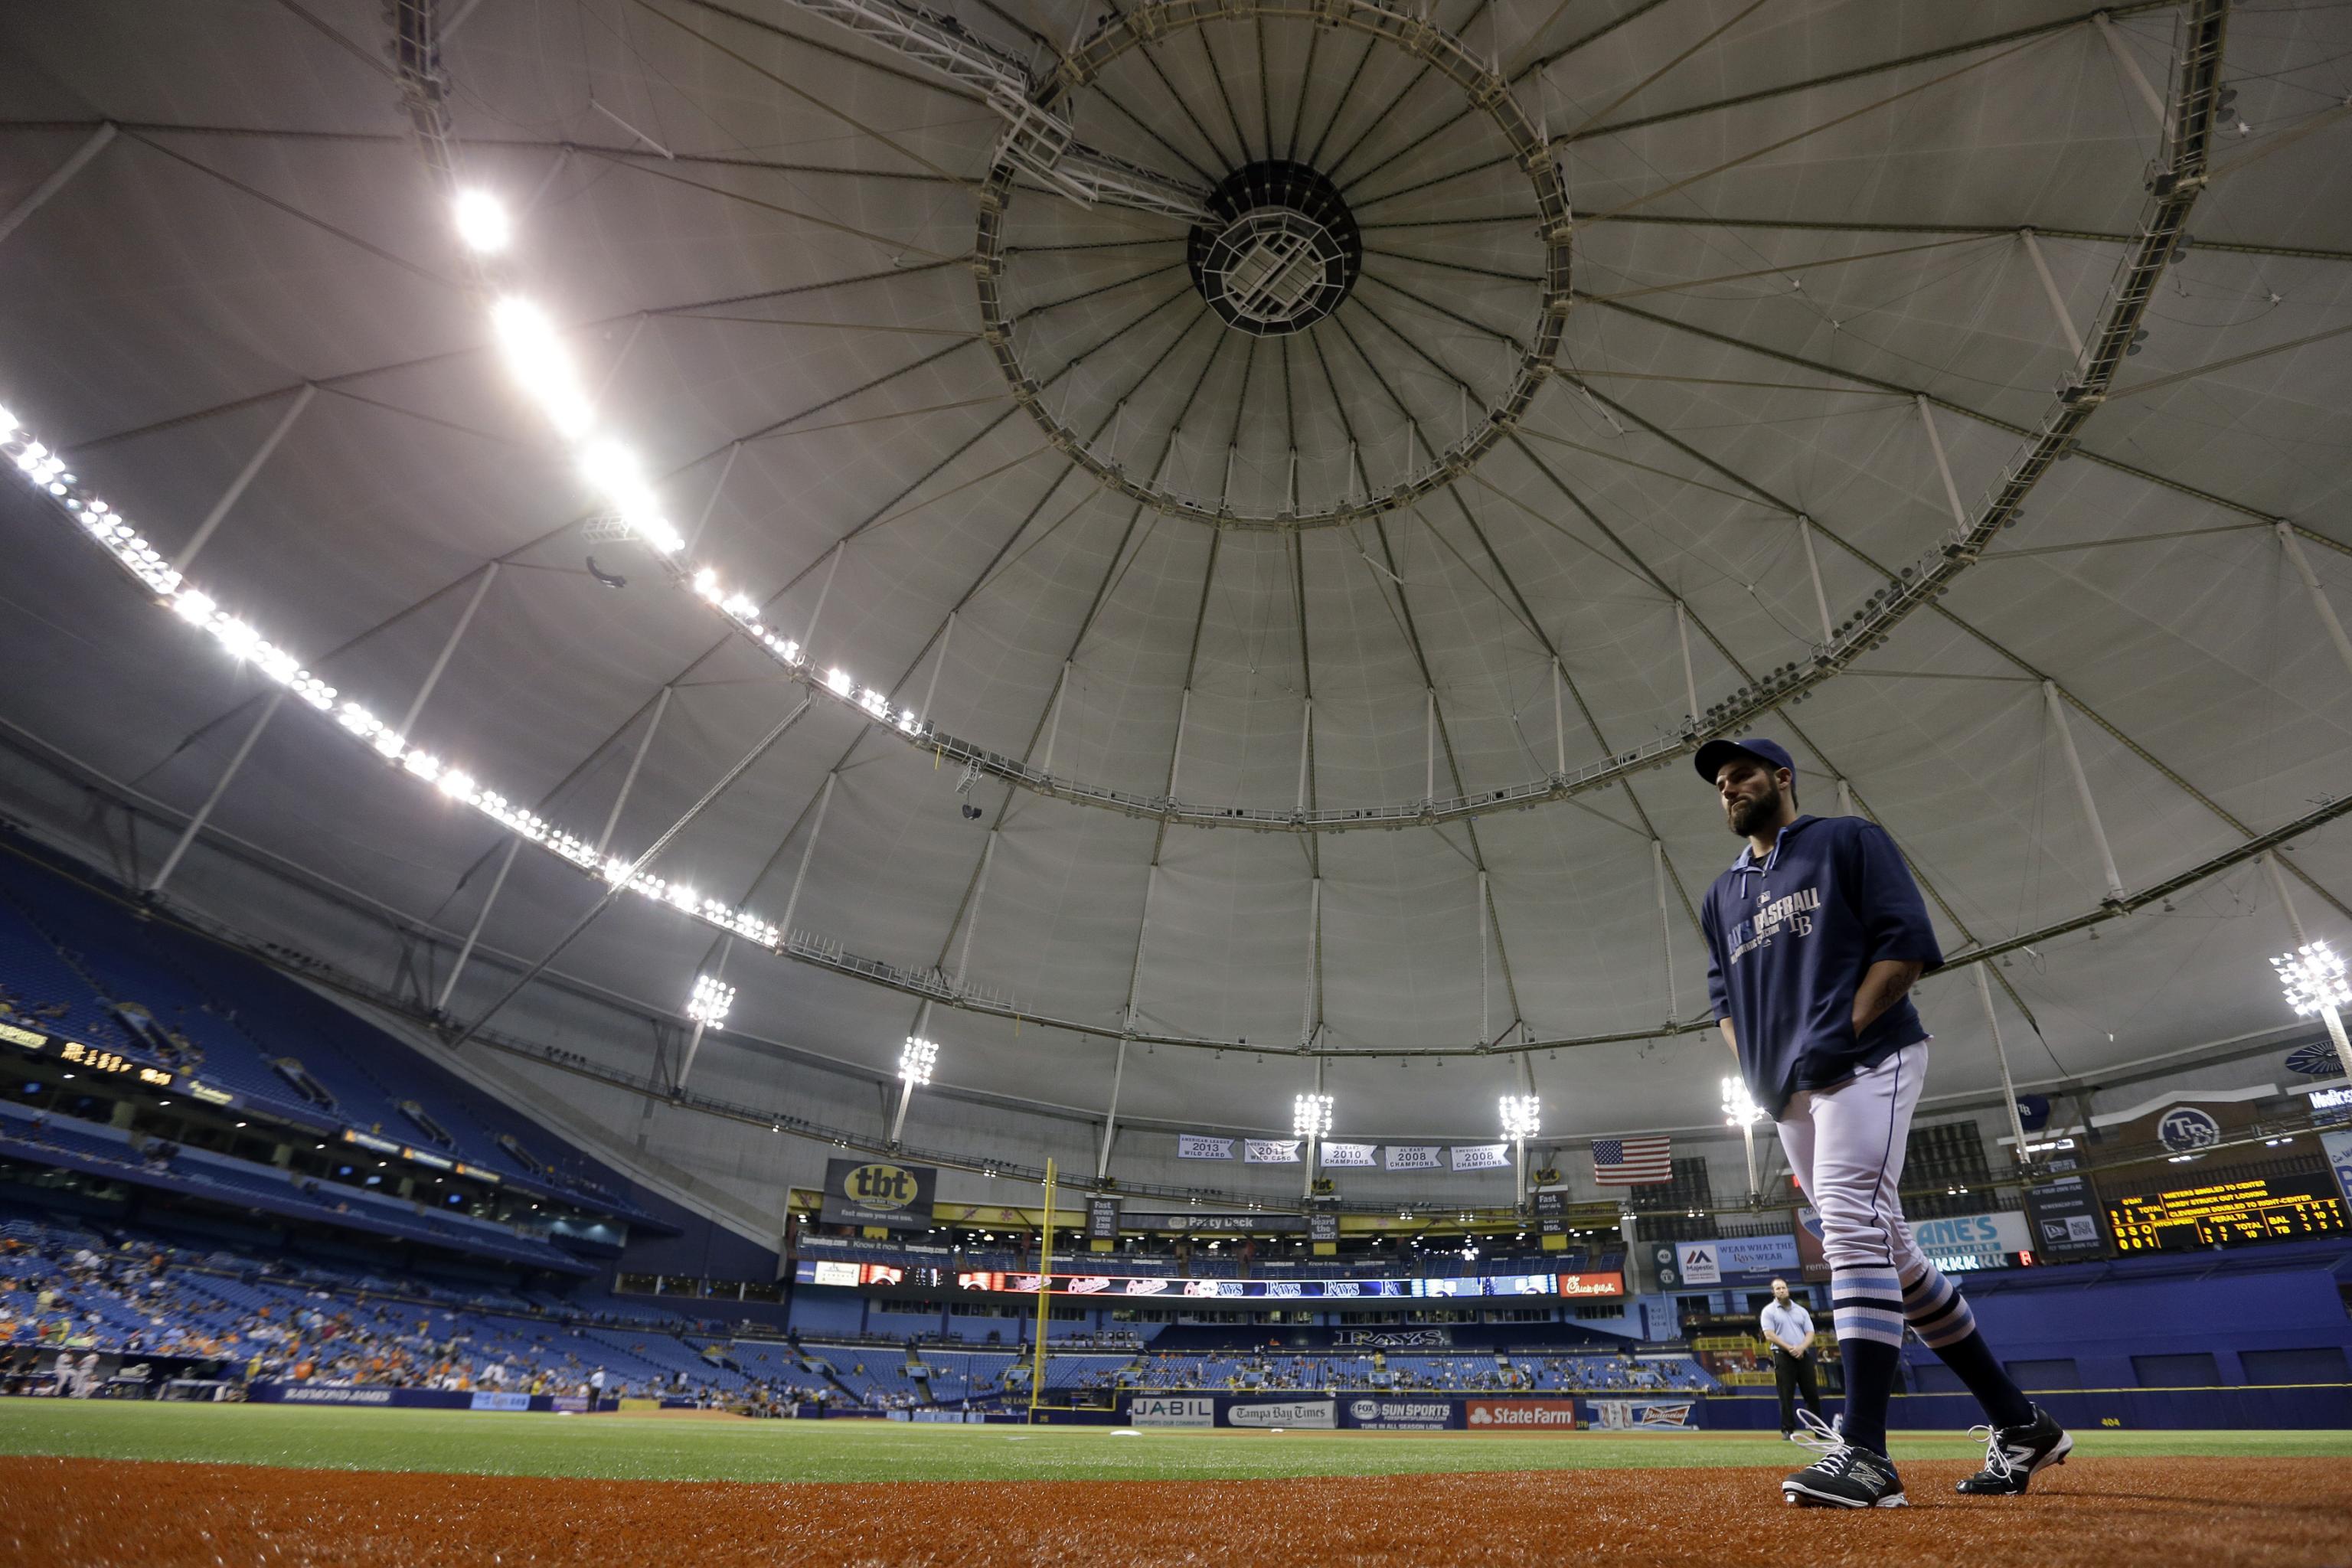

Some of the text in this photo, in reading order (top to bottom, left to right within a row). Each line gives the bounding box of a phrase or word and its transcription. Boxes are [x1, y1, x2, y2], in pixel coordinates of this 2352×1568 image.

[1753, 887, 1821, 935] BASEBALL
[1783, 911, 1812, 937] TB
[1193, 1143, 1219, 1152] 2013
[1334, 1151, 1361, 1159] 2010
[1398, 1152, 1426, 1161] 2008
[1465, 1152, 1493, 1161] 2008
[1456, 1160, 1502, 1168] CHAMPIONS
[856, 1168, 908, 1199] tbt
[2235, 1180, 2266, 1190] CENTER
[2234, 1190, 2269, 1200] LOOKING
[1095, 1200, 1111, 1209] Fast
[2210, 1203, 2246, 1212] DOUBLED
[2257, 1194, 2312, 1207] RIGHT-CENTER
[2295, 1204, 2305, 1212] R
[2327, 1200, 2337, 1208] E
[2138, 1205, 2164, 1214] TOTAL
[1189, 1217, 1222, 1228] Party
[1225, 1217, 1253, 1227] Deck
[2209, 1213, 2249, 1223] PERALTA
[2267, 1216, 2290, 1225] BAL
[1916, 1216, 1998, 1246] ANE'S
[2115, 1227, 2125, 1237] B
[2127, 1226, 2138, 1236] S
[2234, 1222, 2264, 1231] TOTAL
[2274, 1226, 2291, 1234] TB
[2303, 1223, 2312, 1231] 3
[2319, 1221, 2328, 1230] 5
[2245, 1230, 2258, 1238] 10
[1748, 1243, 1774, 1252] WHAT
[1775, 1242, 1794, 1250] THE
[2118, 1236, 2154, 1250] 0 0 1
[1756, 1253, 1783, 1261] WEAR
[1687, 1264, 1714, 1272] Majestic
[1805, 1263, 1831, 1272] rema
[1217, 1282, 1243, 1296] AYS
[1264, 1282, 1302, 1296] RAYS
[1322, 1282, 1360, 1296] RAYS
[1135, 1401, 1211, 1416] JABIL
[1236, 1406, 1326, 1421] Tampa Bay Times
[1357, 1404, 1376, 1413] FOX
[1381, 1403, 1451, 1416] SUN SPORTS
